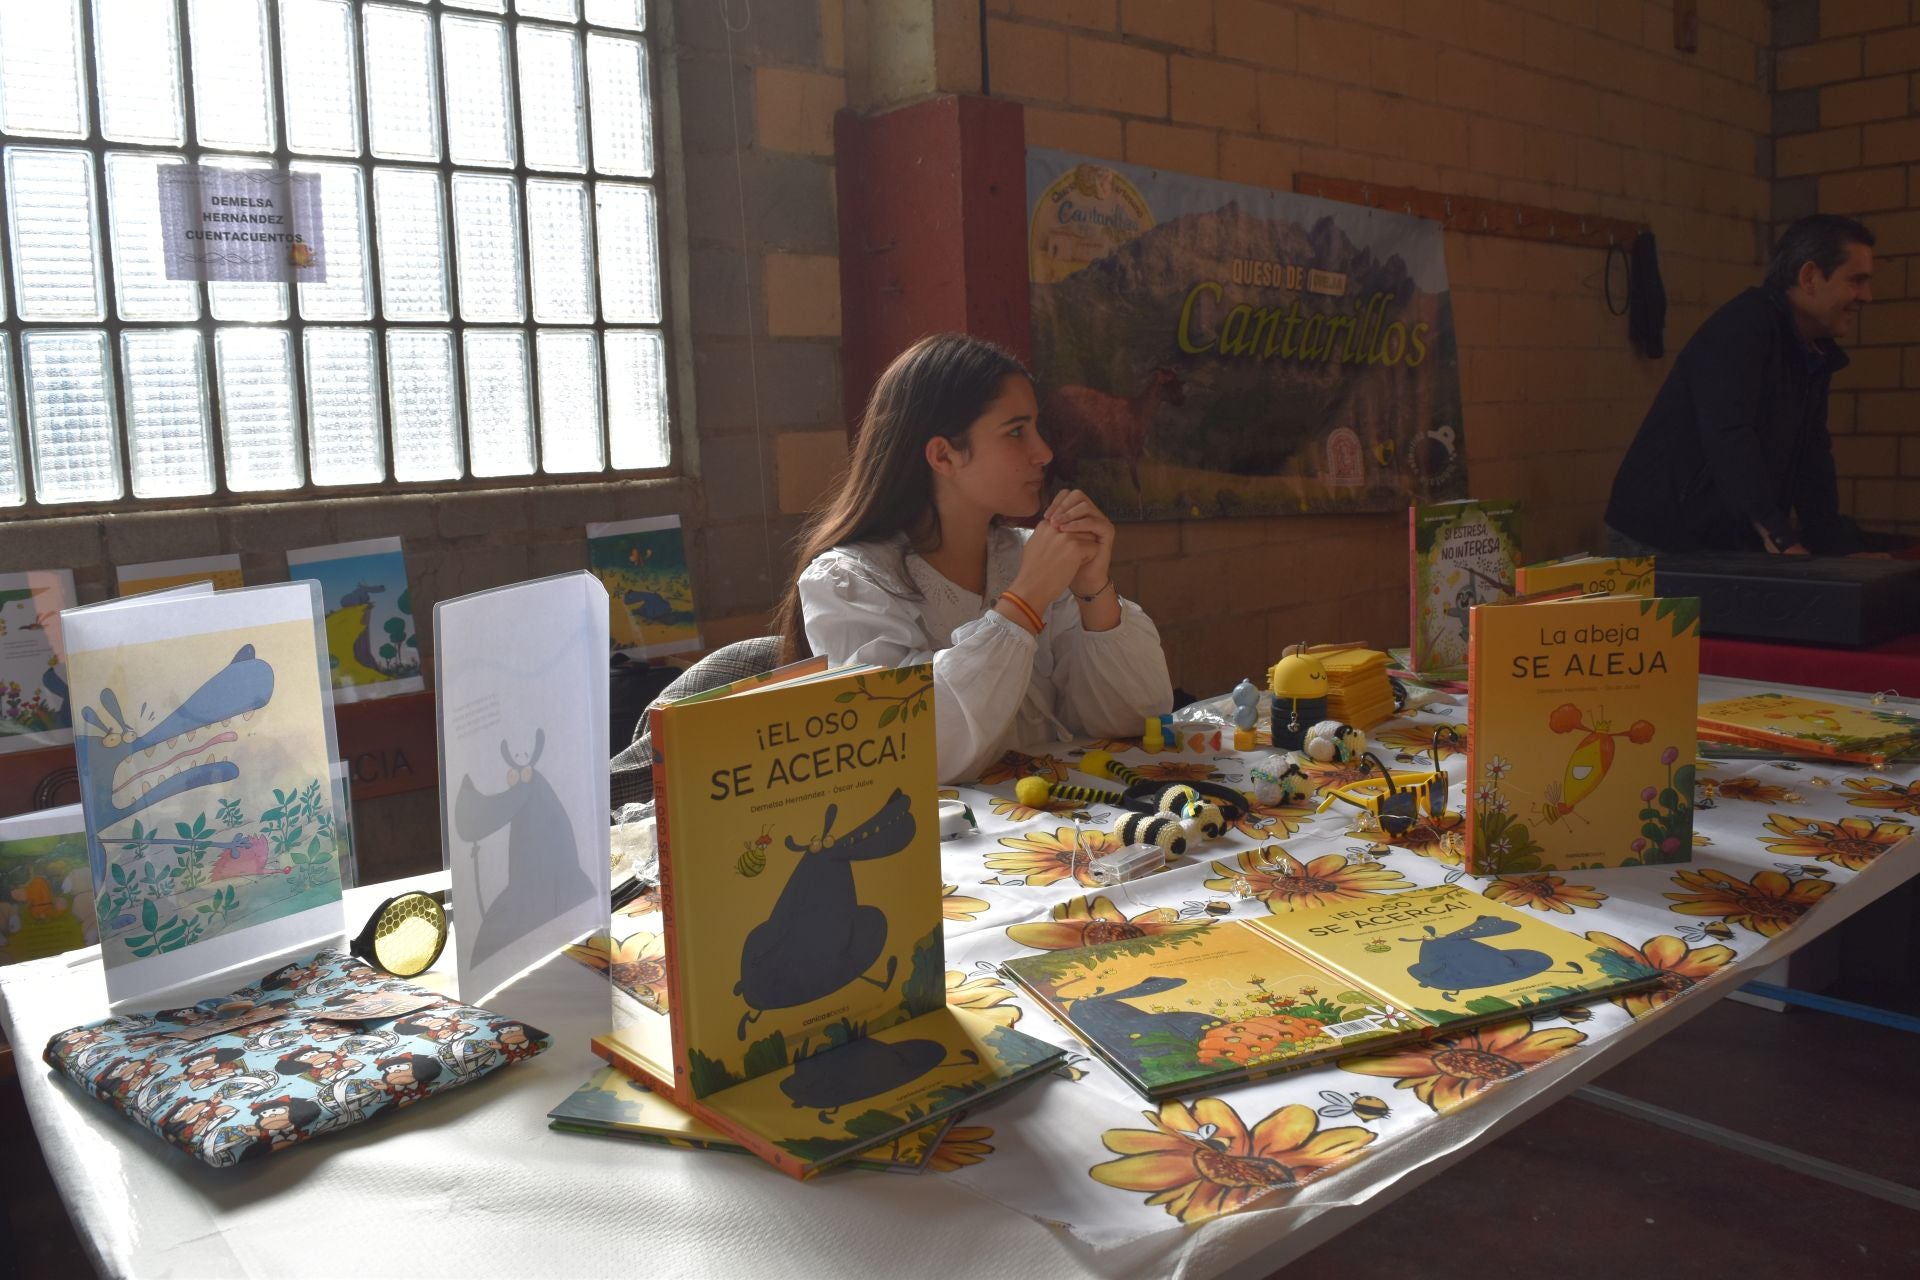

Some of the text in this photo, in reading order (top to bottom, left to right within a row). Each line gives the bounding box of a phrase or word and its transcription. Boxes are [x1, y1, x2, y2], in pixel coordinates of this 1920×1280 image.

[211, 196, 274, 208] DEMELSA
[186, 230, 303, 243] CUENTACUENTOS
[1232, 258, 1282, 288] QUESO
[1286, 265, 1304, 290] DE
[1177, 281, 1430, 368] Cantarillos
[1444, 524, 1489, 540] SI ESTRESA,
[1441, 547, 1454, 560] NO
[1589, 579, 1616, 593] OSO
[1540, 624, 1640, 647] La abeja
[1511, 651, 1668, 679] SE ALEJA
[756, 709, 859, 751] ¡EL OSO
[710, 732, 907, 802] SE ACERCA!
[750, 800, 784, 814] Demelsa
[785, 790, 825, 805] Hernández
[833, 783, 854, 794] Óscar
[855, 779, 875, 789] Julve
[660, 840, 669, 859] SE
[1367, 901, 1413, 913] OSO
[1308, 924, 1350, 937] SE
[1354, 901, 1472, 929] ACERCA!
